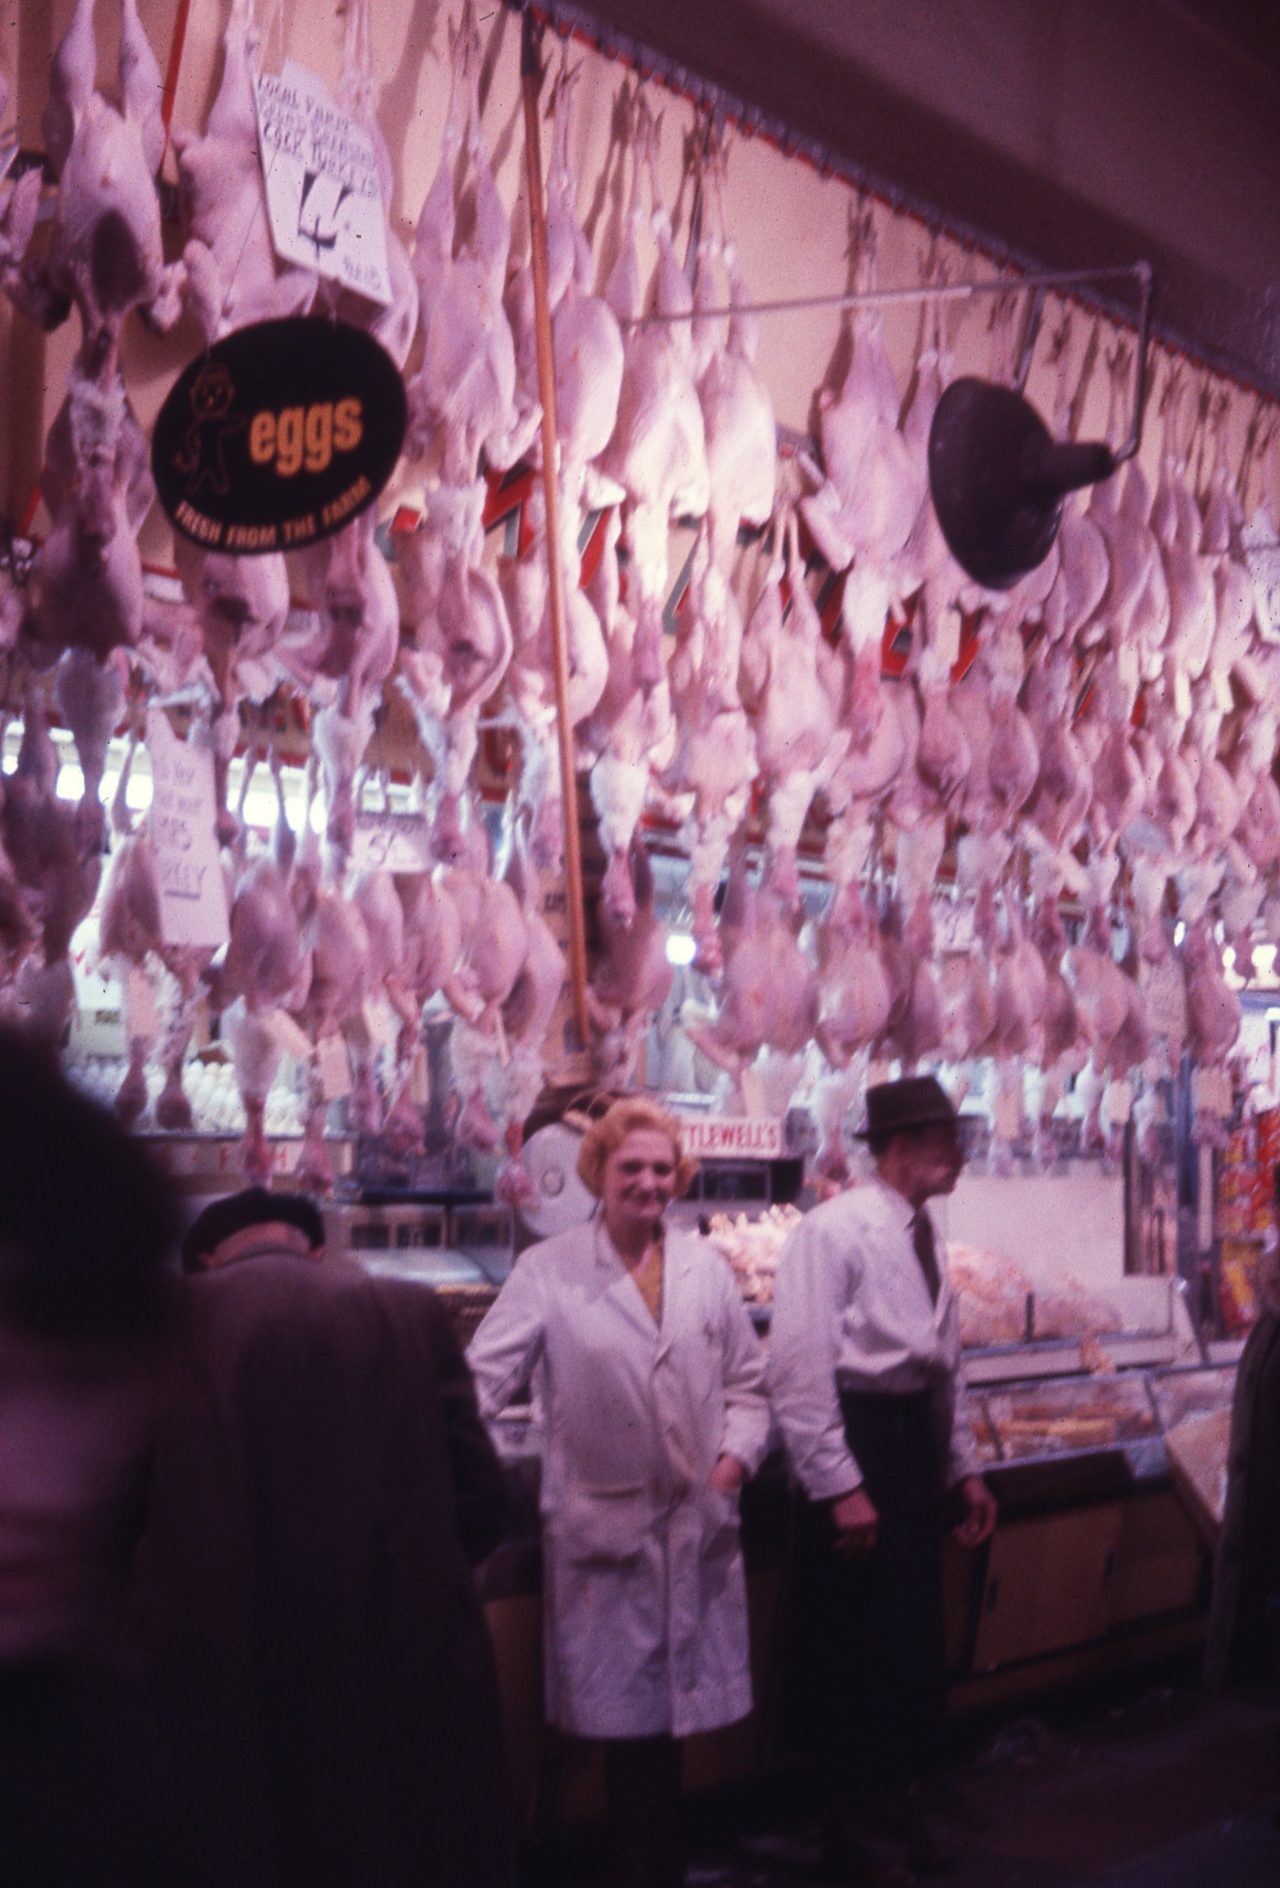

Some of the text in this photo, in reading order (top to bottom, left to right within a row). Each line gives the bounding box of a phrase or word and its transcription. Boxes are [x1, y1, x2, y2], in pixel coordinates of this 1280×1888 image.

[251, 396, 363, 478] eggs
[175, 500, 223, 543] FRESH
[226, 525, 277, 548] FROM
[283, 513, 317, 544] THE
